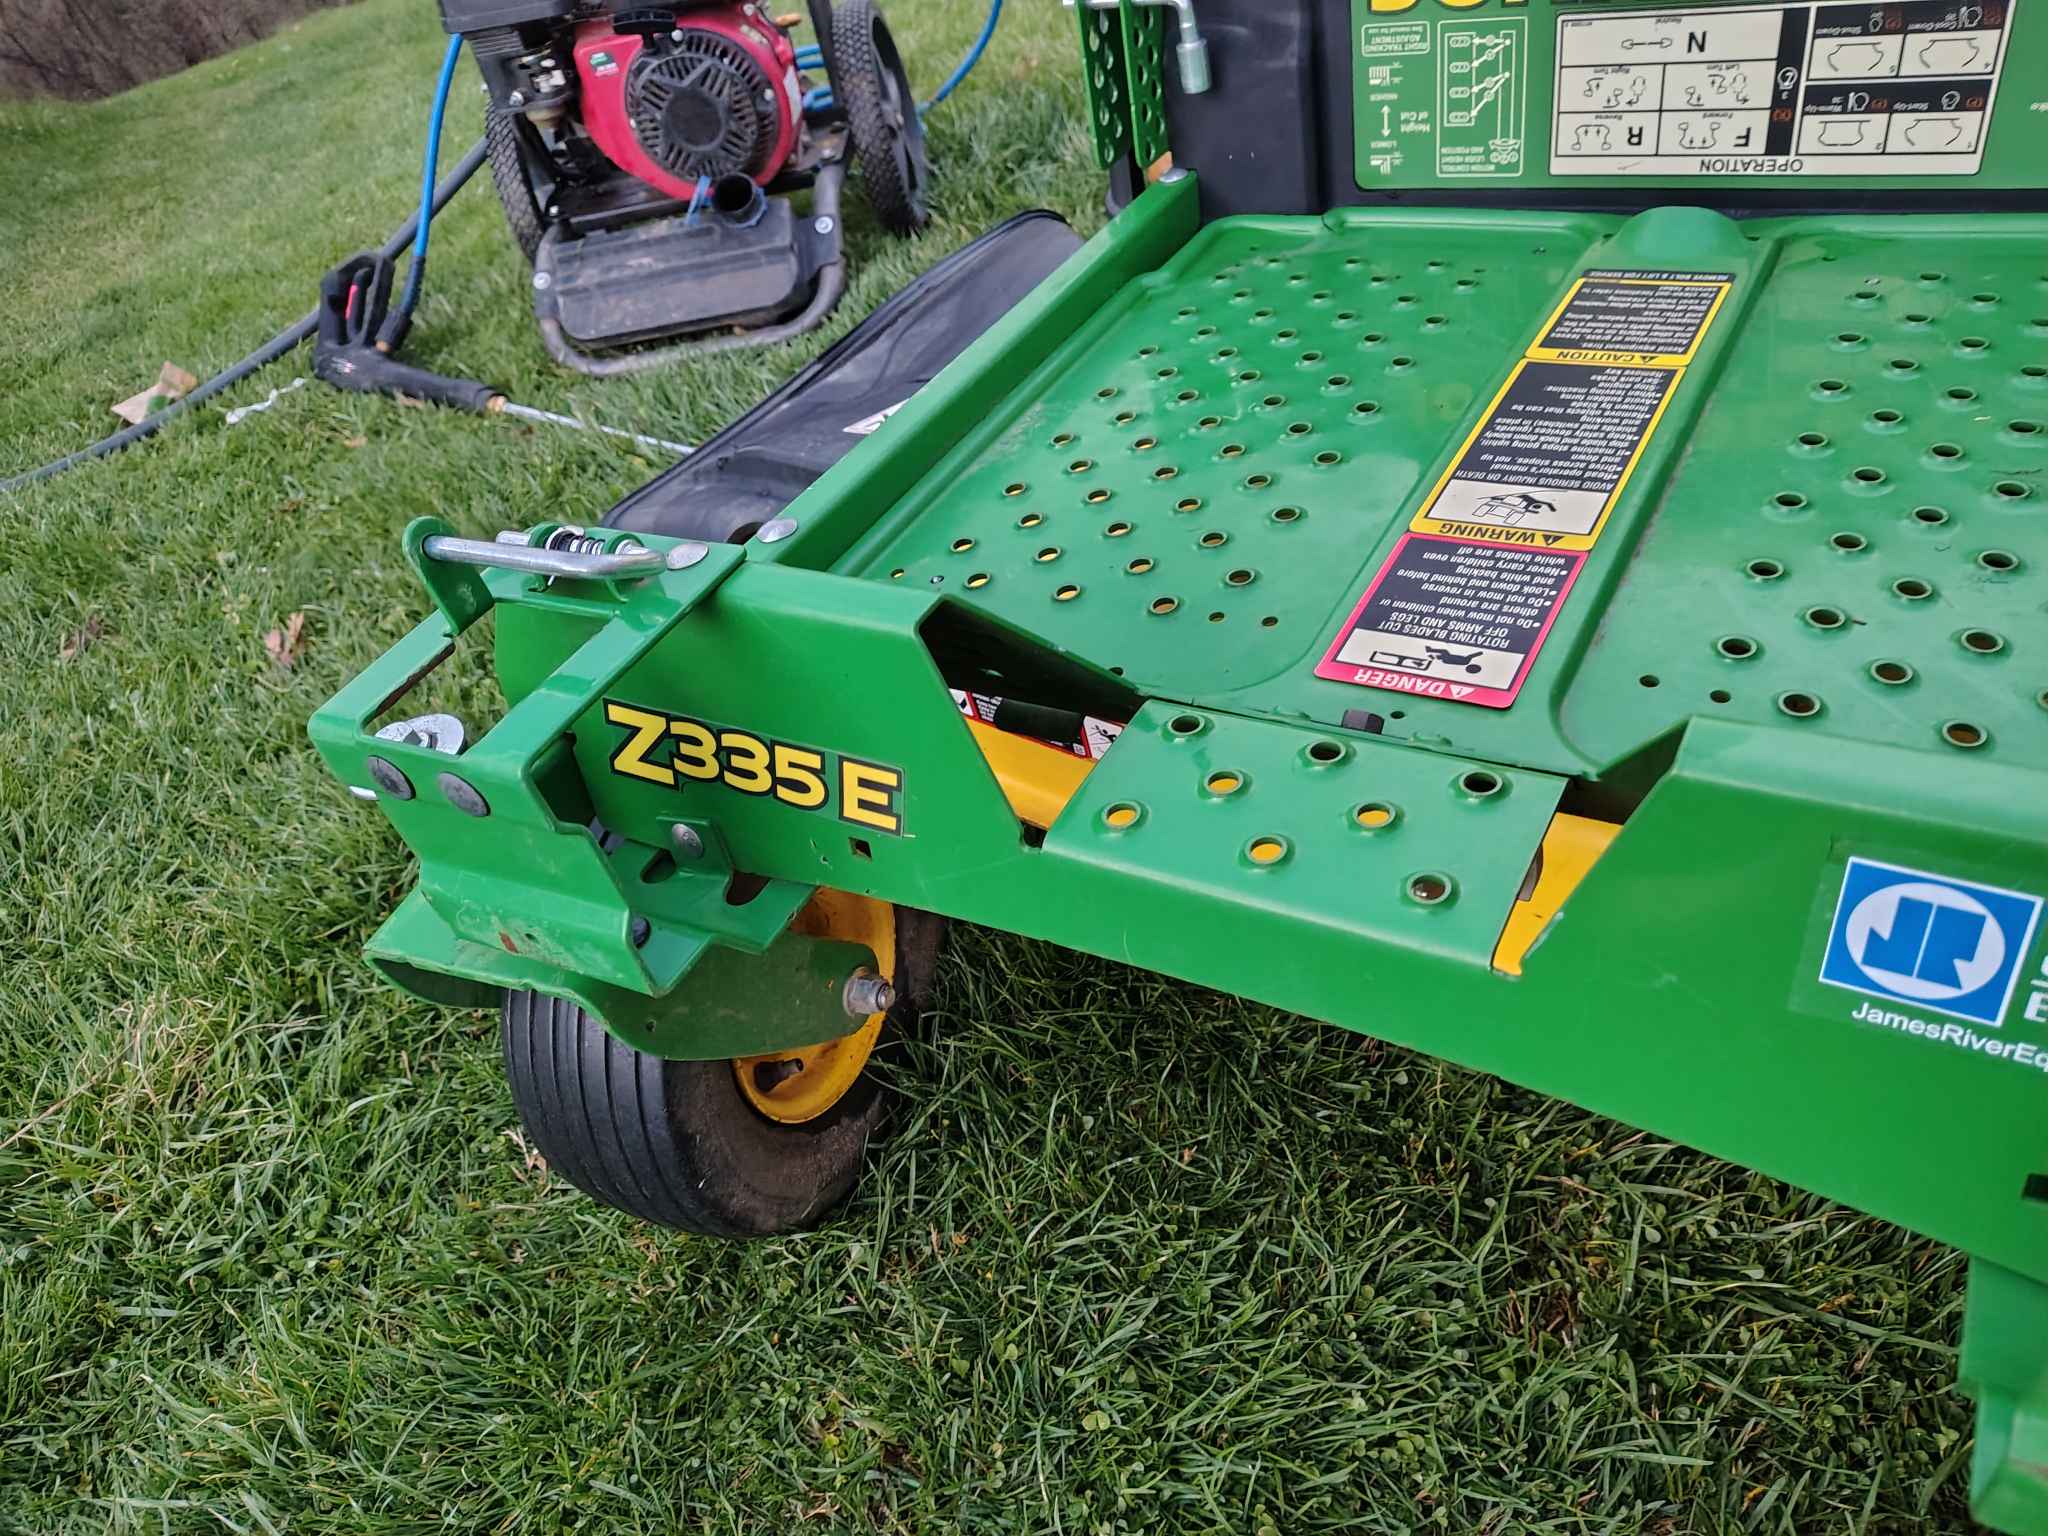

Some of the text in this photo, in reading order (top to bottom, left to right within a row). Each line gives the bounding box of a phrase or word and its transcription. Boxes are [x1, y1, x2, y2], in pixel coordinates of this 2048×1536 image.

[1687, 31, 1706, 53] N
[1627, 126, 1643, 145] R
[1734, 127, 1751, 147] F
[1700, 158, 1803, 172] OPERATION
[1557, 349, 1636, 365] CAUTION
[1480, 453, 1495, 462] up
[1495, 455, 1513, 464] not
[1552, 459, 1587, 470] across
[1570, 453, 1622, 465] and down
[1455, 470, 1487, 480] DEATH
[1486, 473, 1503, 481] OR
[1490, 463, 1529, 474] manual
[1584, 471, 1613, 480] Read
[1588, 463, 1618, 473] Drive
[1537, 477, 1582, 489] SERIOUS
[1582, 480, 1615, 492] AVOID
[1438, 522, 1539, 545] WARNING
[1422, 552, 1561, 577] Never carry children even
[1457, 547, 1567, 567] while blades are off
[1396, 569, 1550, 596] Look down and behind before
[1455, 566, 1556, 587] and while backing
[1421, 583, 1545, 607] Do not mow in reverse
[1379, 599, 1534, 628] Do not mow when children or
[1439, 596, 1540, 618] others are around
[1389, 612, 1510, 638] OFF ARMS AND LEGS
[1377, 621, 1511, 649] ROTATING BLADES CUT
[1352, 669, 1448, 696] DANGER
[604, 700, 900, 834] Z335 E
